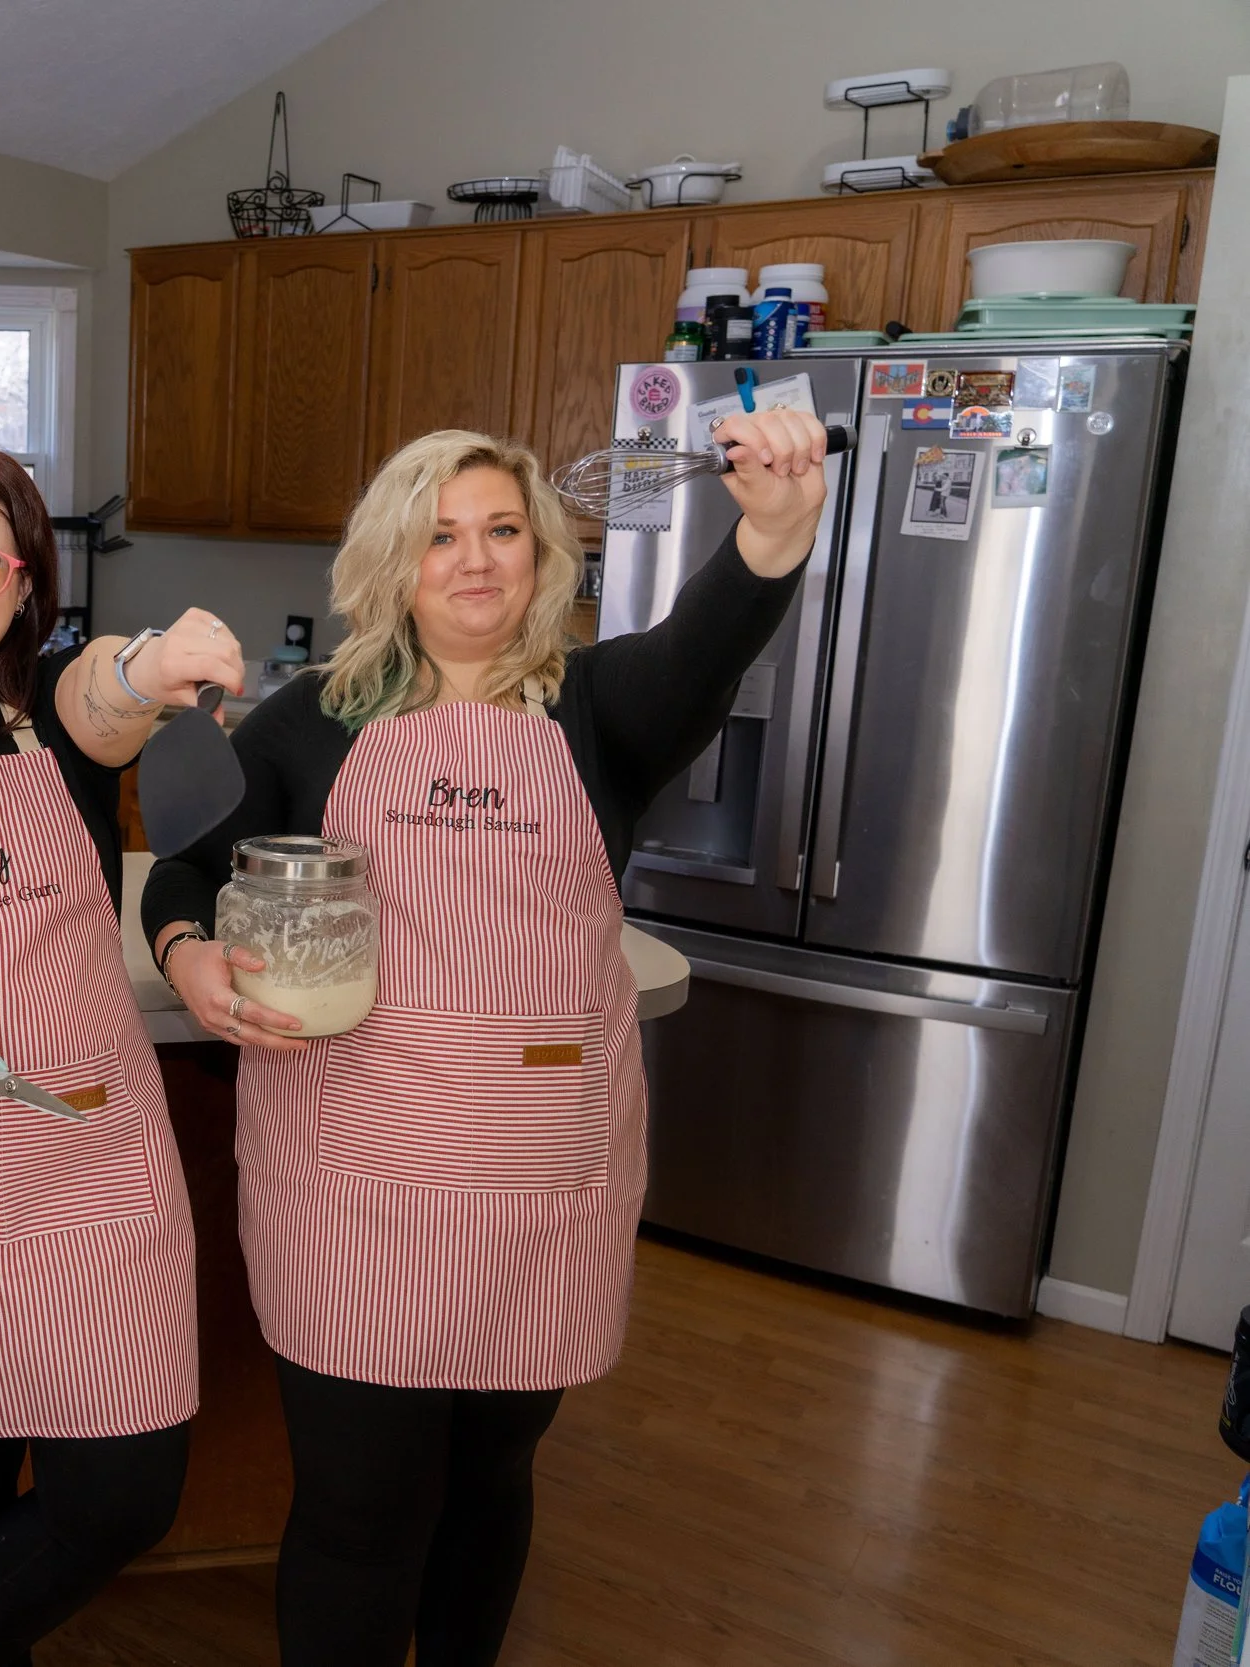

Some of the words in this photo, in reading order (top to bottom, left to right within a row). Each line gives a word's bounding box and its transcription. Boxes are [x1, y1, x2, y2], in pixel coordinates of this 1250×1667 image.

[638, 376, 671, 395] CAKED
[638, 396, 669, 414] BAKED
[428, 777, 505, 810] Bren
[385, 810, 475, 831] Sourdough
[483, 817, 541, 834] Savant
[19, 881, 62, 902] Guru
